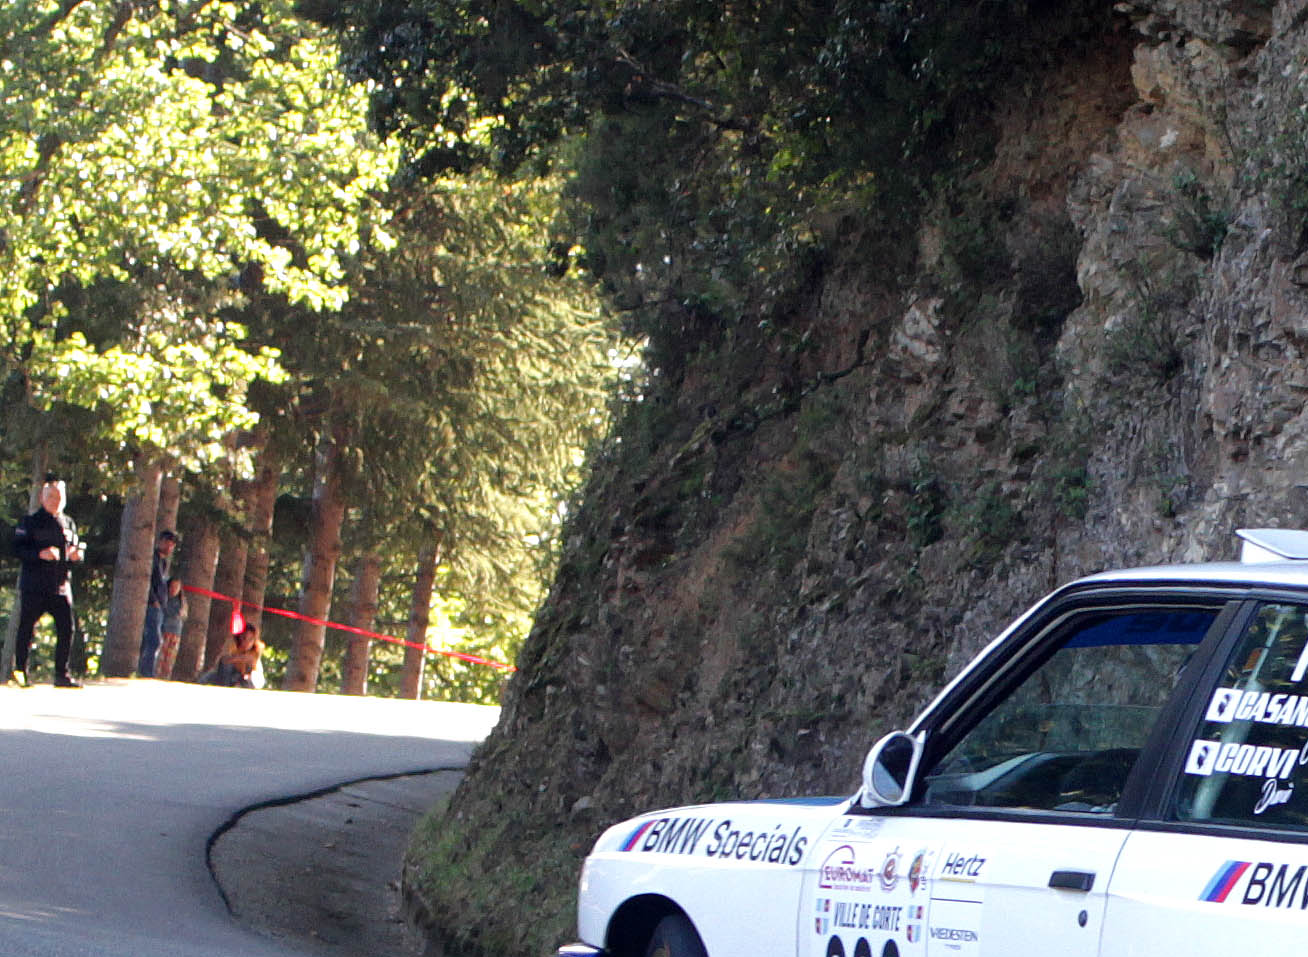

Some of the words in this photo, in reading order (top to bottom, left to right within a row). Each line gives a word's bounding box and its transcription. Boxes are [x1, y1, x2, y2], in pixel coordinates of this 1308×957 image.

[1214, 742, 1301, 779] CORVI
[641, 817, 714, 855] BMW
[705, 819, 808, 866] Specials
[940, 852, 987, 878] Hertz
[834, 902, 859, 928] VILLE
[859, 903, 872, 930] DE
[872, 905, 903, 932] CORTE
